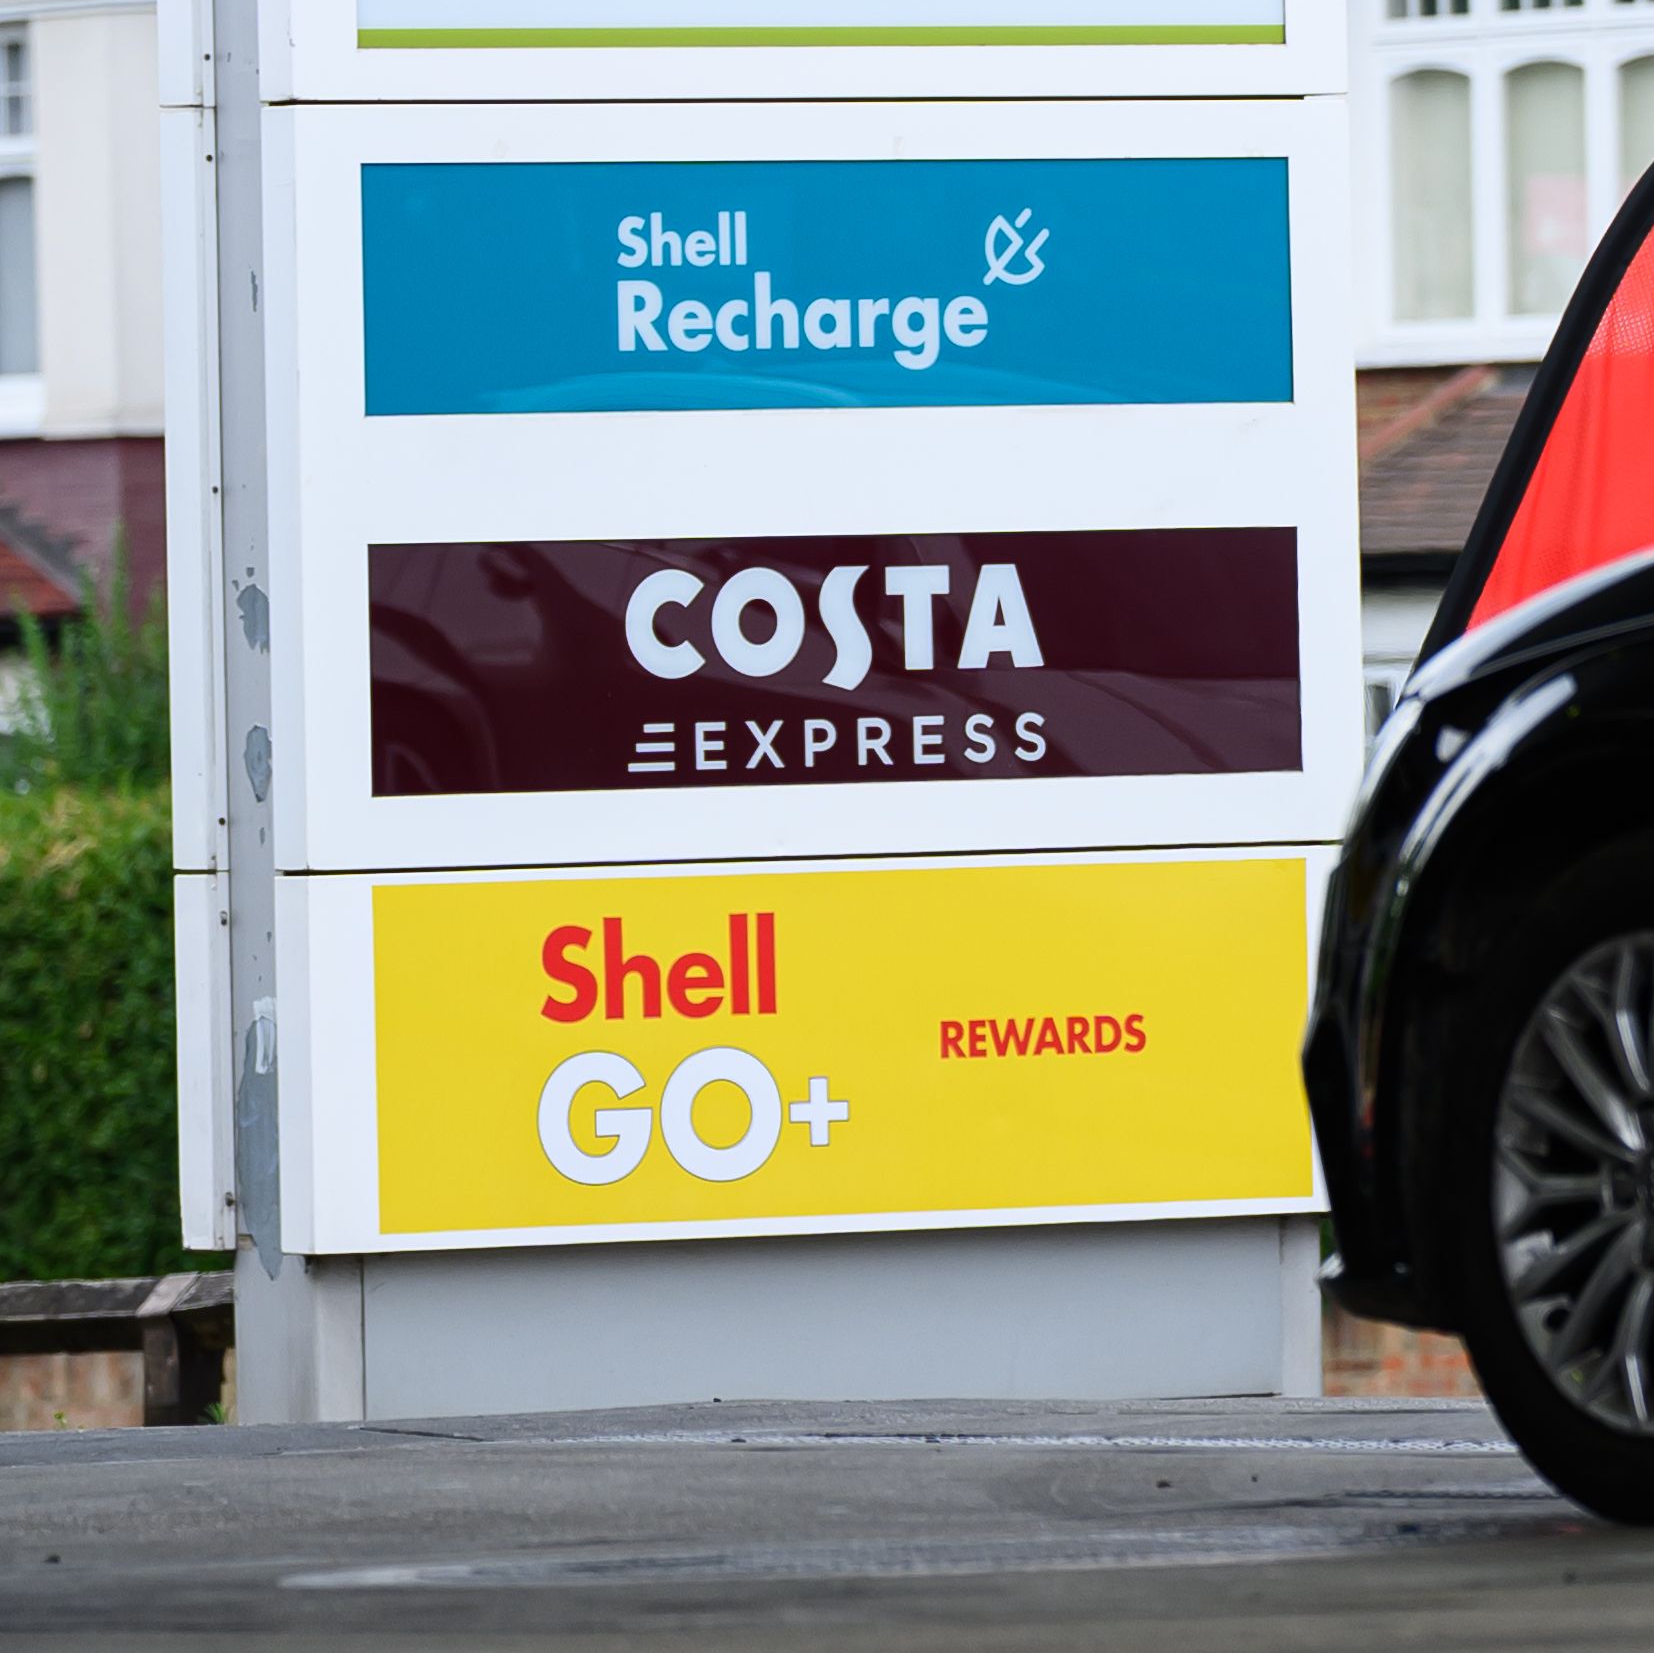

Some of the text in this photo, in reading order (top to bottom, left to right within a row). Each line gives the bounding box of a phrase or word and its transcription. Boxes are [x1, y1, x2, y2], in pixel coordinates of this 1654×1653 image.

[618, 211, 748, 268] Shell
[617, 272, 989, 370] Recharge
[625, 563, 1045, 691] COSTA
[695, 712, 1047, 771] EXPRESS
[541, 912, 777, 1023] Shell
[940, 1013, 1147, 1059] REWARDS
[536, 1046, 850, 1186] GO+
